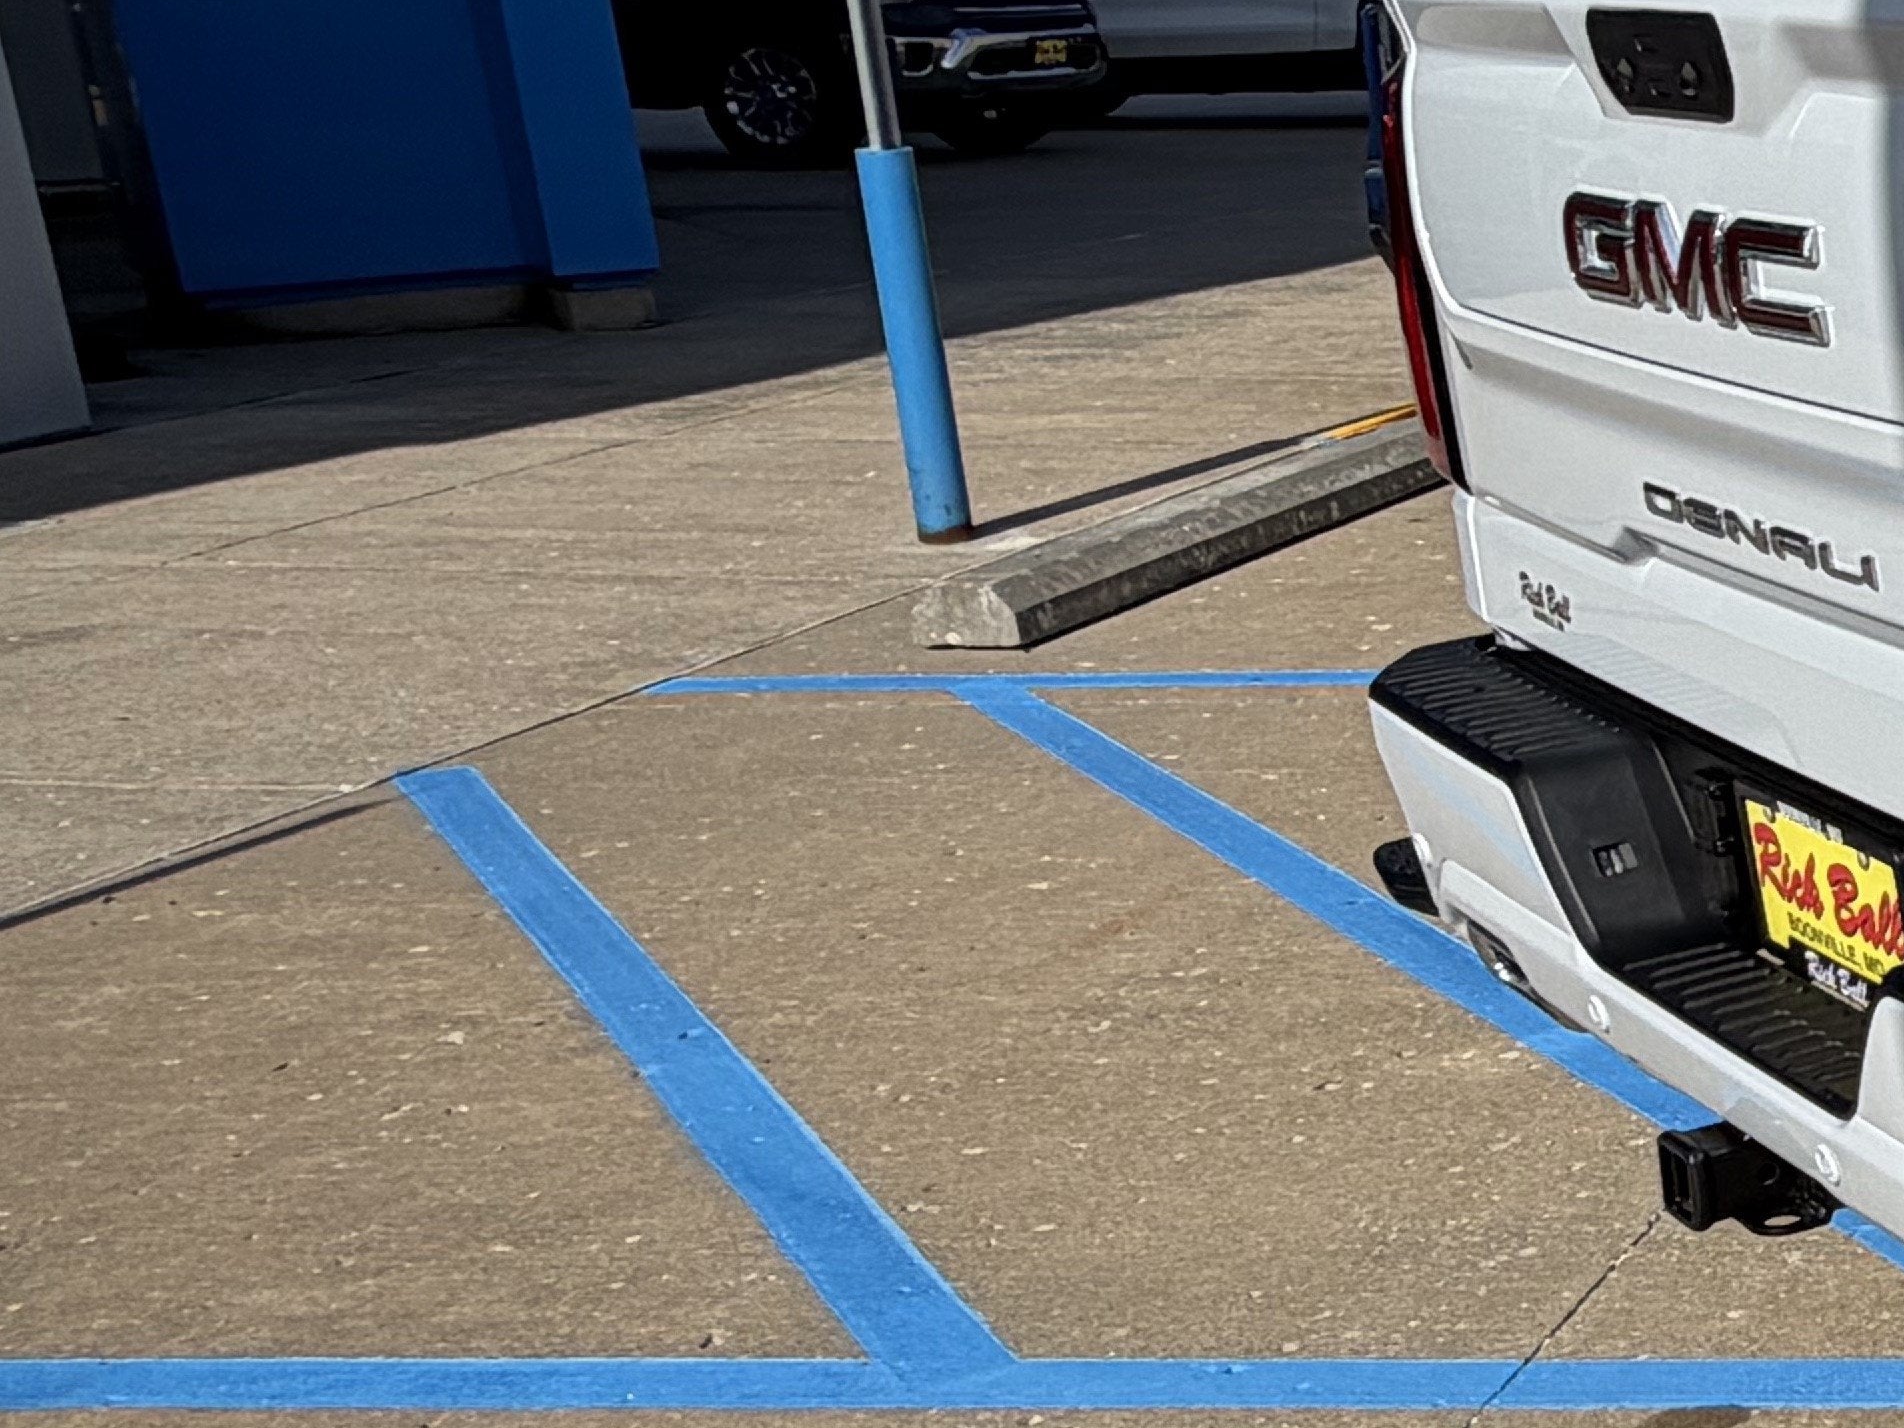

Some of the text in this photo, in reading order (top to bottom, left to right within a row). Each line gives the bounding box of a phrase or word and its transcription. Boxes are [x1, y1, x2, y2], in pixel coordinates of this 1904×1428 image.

[1563, 189, 1834, 348] GMC
[1643, 482, 1881, 592] DENALI
[1754, 822, 1825, 920] Rick
